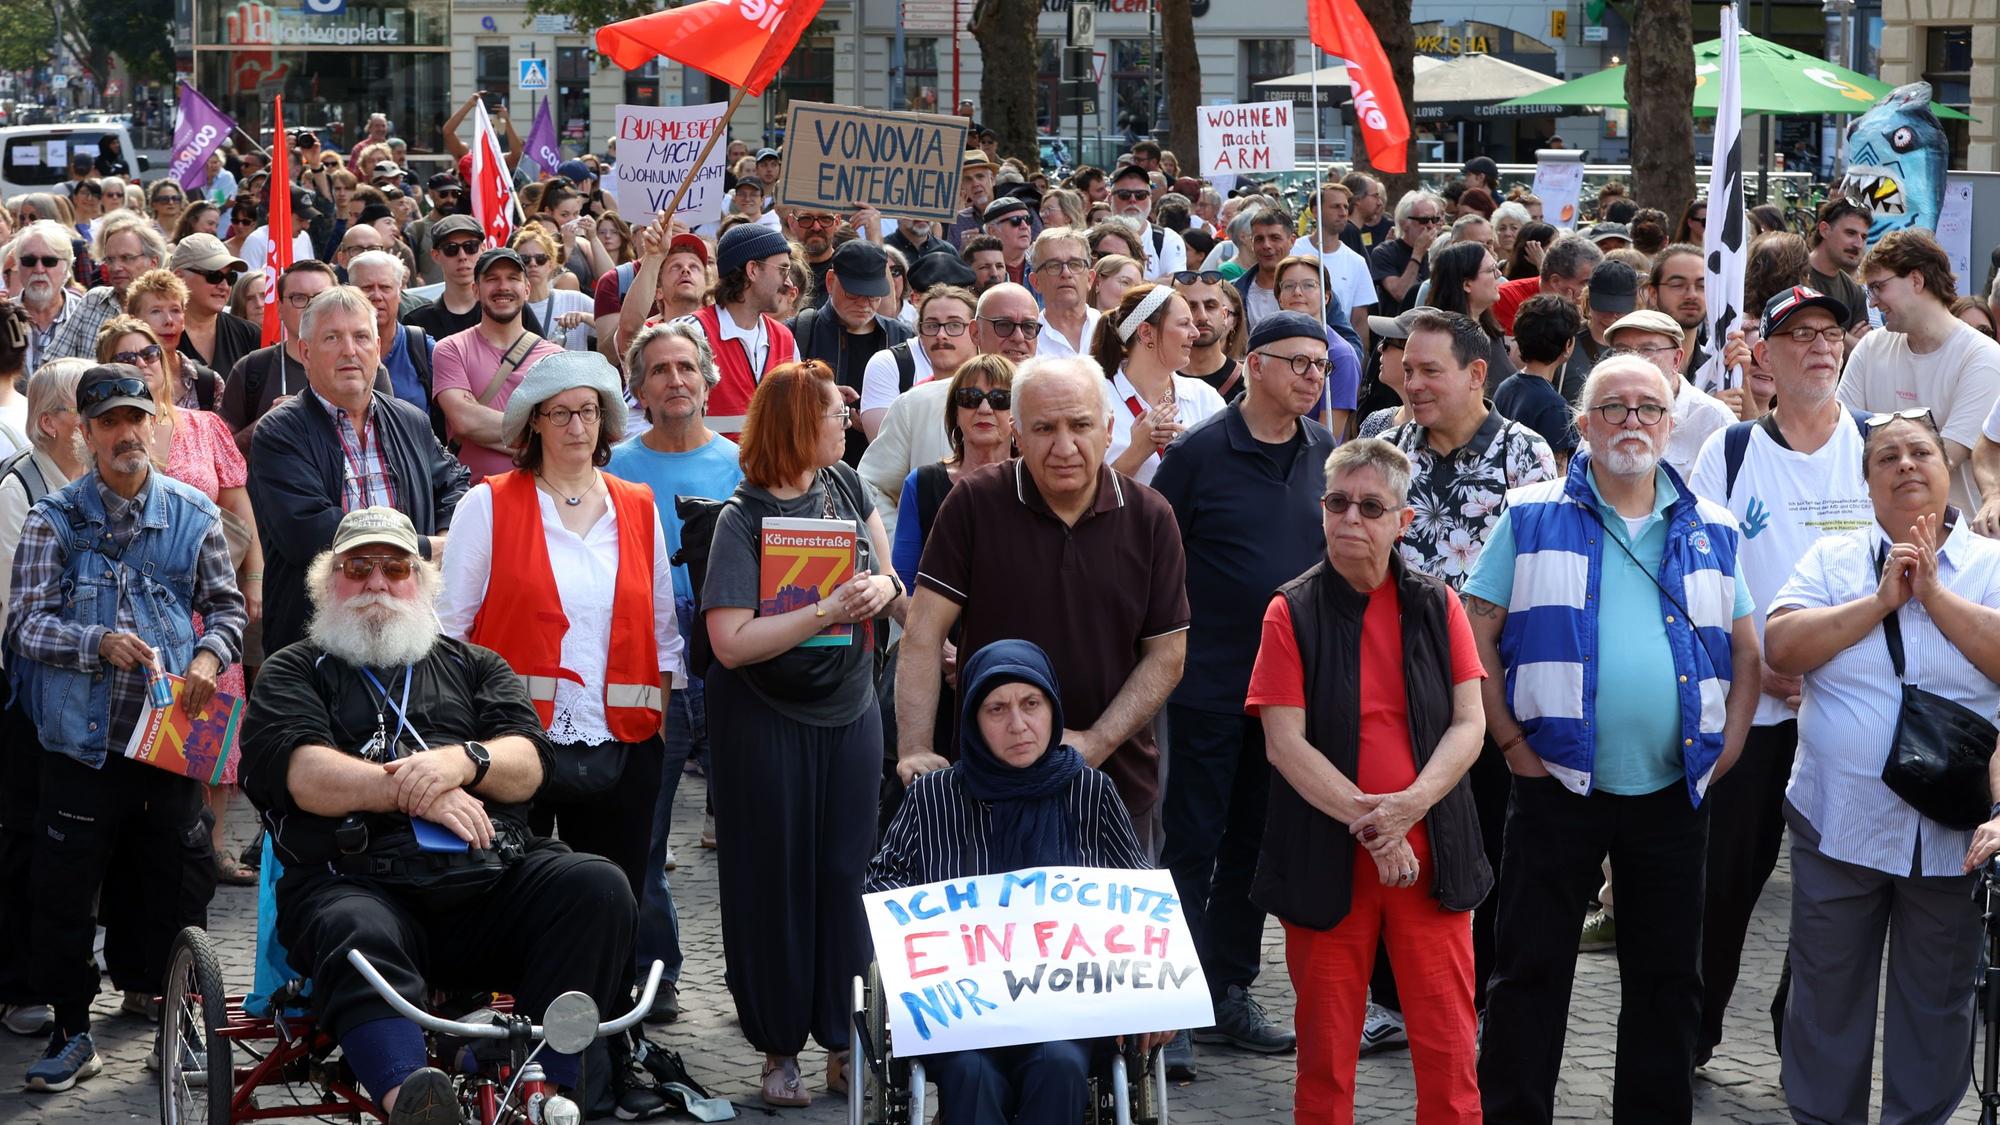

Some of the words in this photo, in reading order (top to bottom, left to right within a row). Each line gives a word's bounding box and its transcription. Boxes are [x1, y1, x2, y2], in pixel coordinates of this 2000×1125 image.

[1298, 91, 1329, 102] FELLWS
[1207, 106, 1288, 128] WOHNEN
[1482, 104, 1517, 116] COFFEE
[1520, 103, 1563, 114] FELLOWS
[815, 119, 944, 166] VONOVIA
[1222, 129, 1267, 147] macht
[646, 140, 701, 164] MACH
[1214, 146, 1271, 171] ARM
[818, 161, 954, 210] ENTEIGNEN
[765, 533, 851, 548] Körnerstraße
[139, 706, 165, 760] Körnerst
[883, 880, 980, 926] ICH
[998, 870, 1180, 923] MÖCHTE
[900, 977, 999, 1041] NUR
[1003, 957, 1199, 1002] WOHNEN
